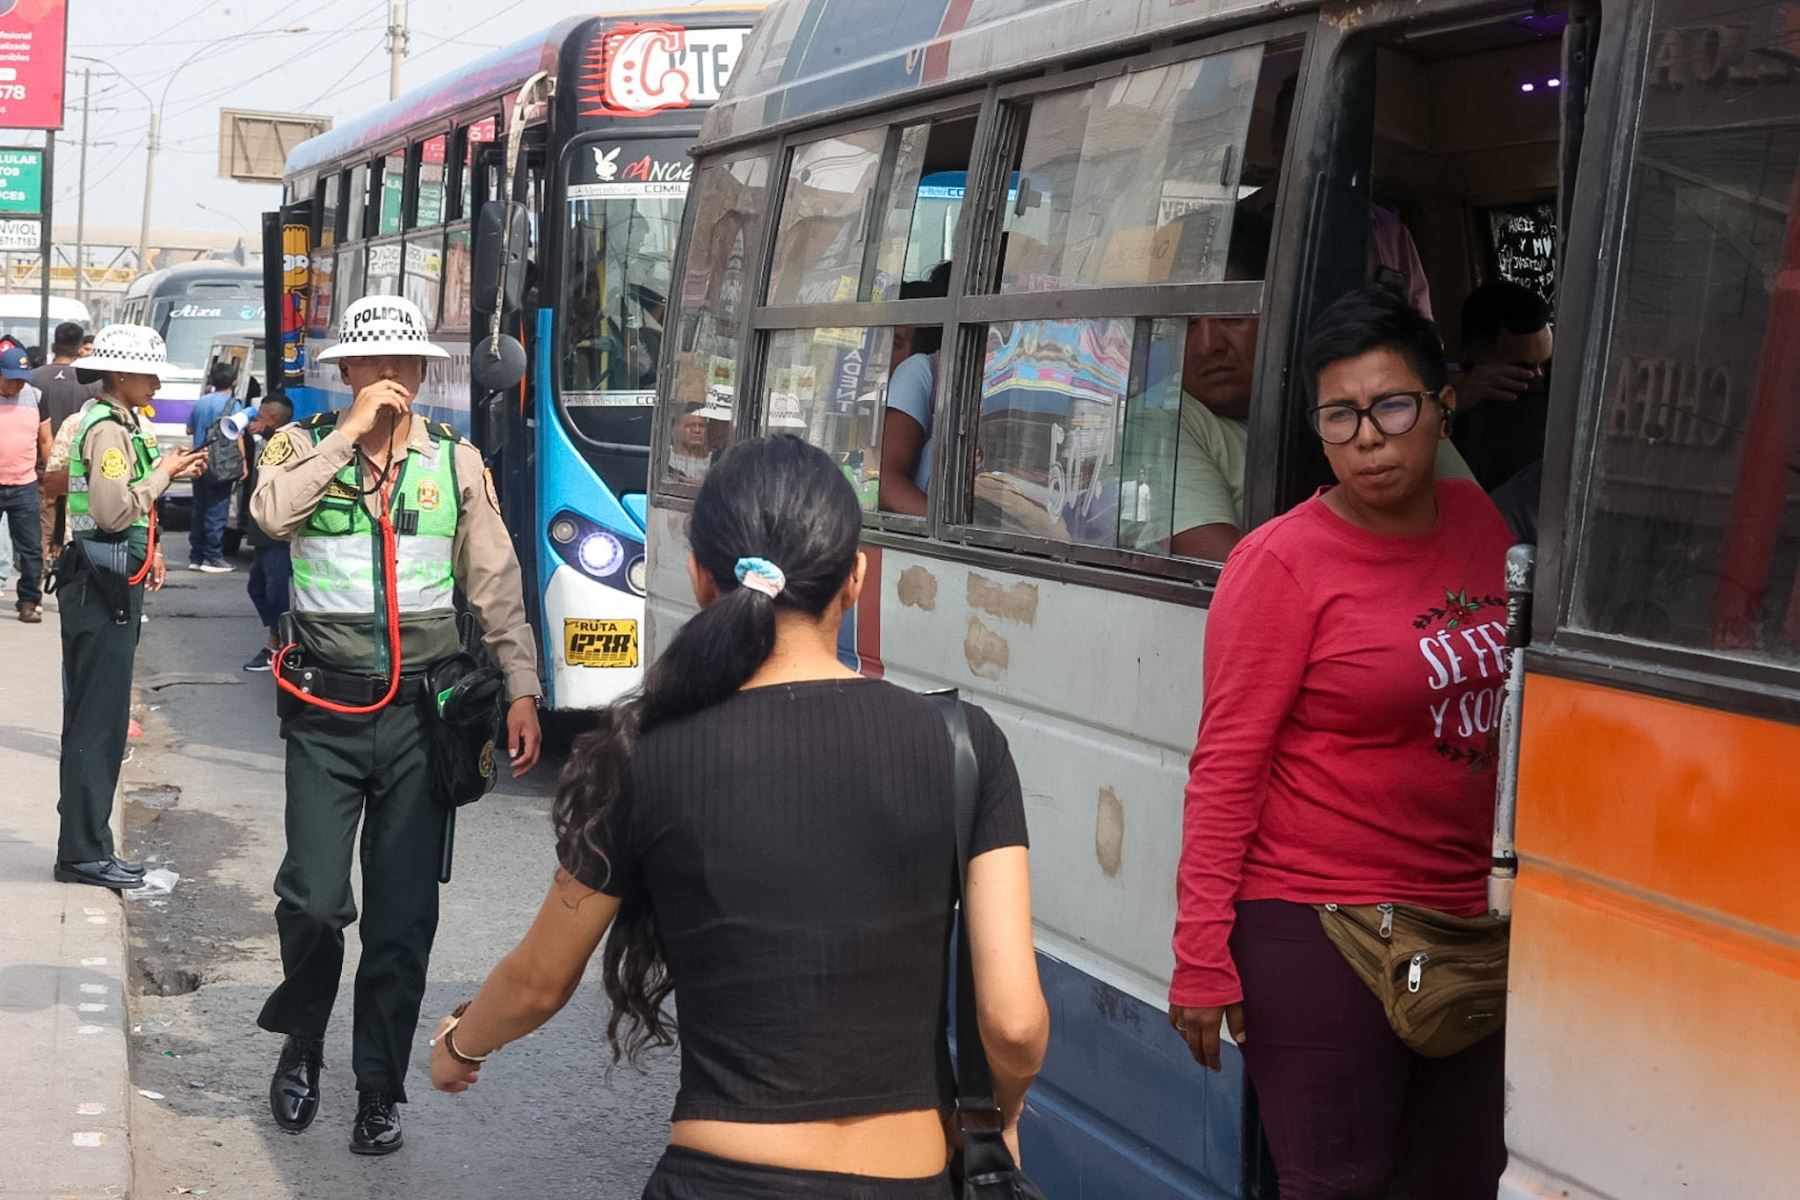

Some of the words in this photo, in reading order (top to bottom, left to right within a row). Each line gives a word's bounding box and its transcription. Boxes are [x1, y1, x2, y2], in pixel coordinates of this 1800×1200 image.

[644, 183, 687, 193] COMIL
[169, 303, 223, 318] Aixa
[580, 622, 618, 632] RUTA
[1419, 629, 1468, 690] SÉ
[1430, 697, 1451, 738] Y
